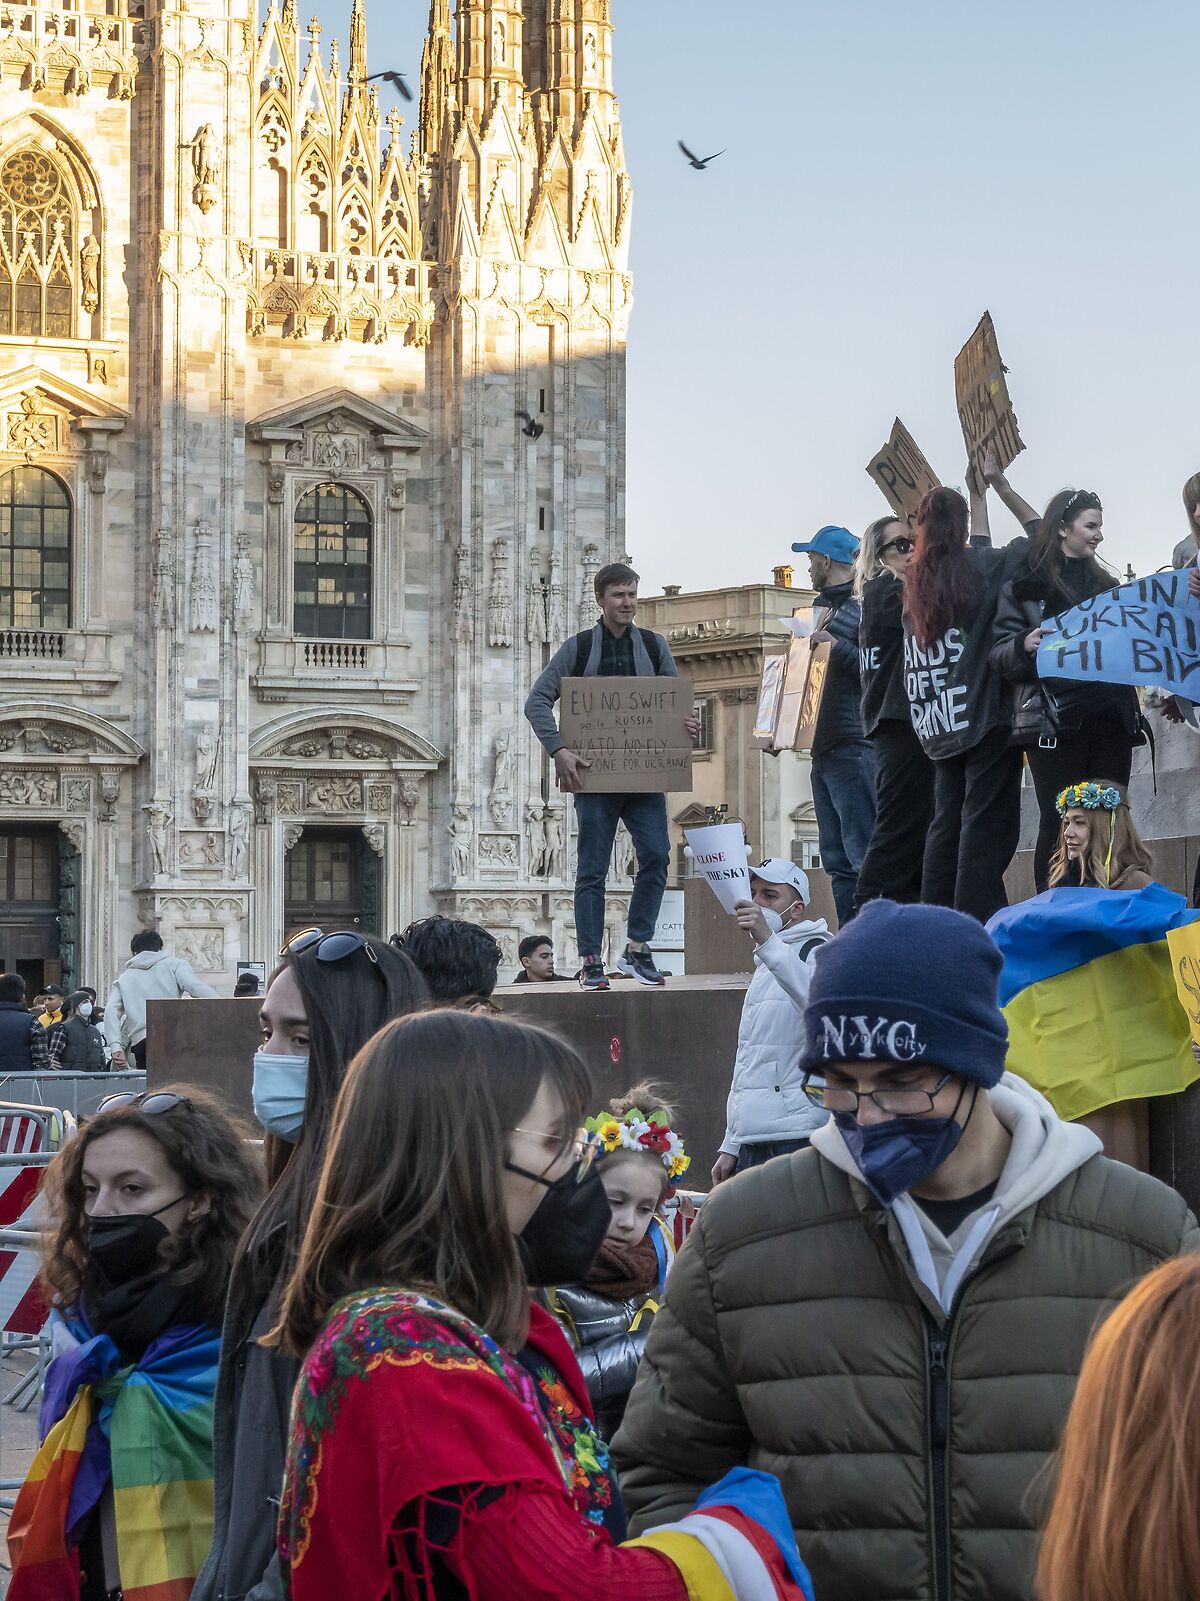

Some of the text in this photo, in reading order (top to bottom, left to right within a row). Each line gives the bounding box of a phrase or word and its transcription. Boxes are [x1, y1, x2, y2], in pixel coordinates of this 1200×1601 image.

[876, 429, 923, 506] PUTIN
[907, 667, 949, 702] OFF
[571, 691, 677, 715] EU NO SWIFT
[615, 715, 653, 726] RUSSIA
[572, 737, 616, 758] NATO
[586, 756, 689, 773] ZONE FOR UKRAINE
[696, 851, 726, 865] CLOSE
[705, 866, 746, 882] THE SKY
[821, 1015, 917, 1061] NYC
